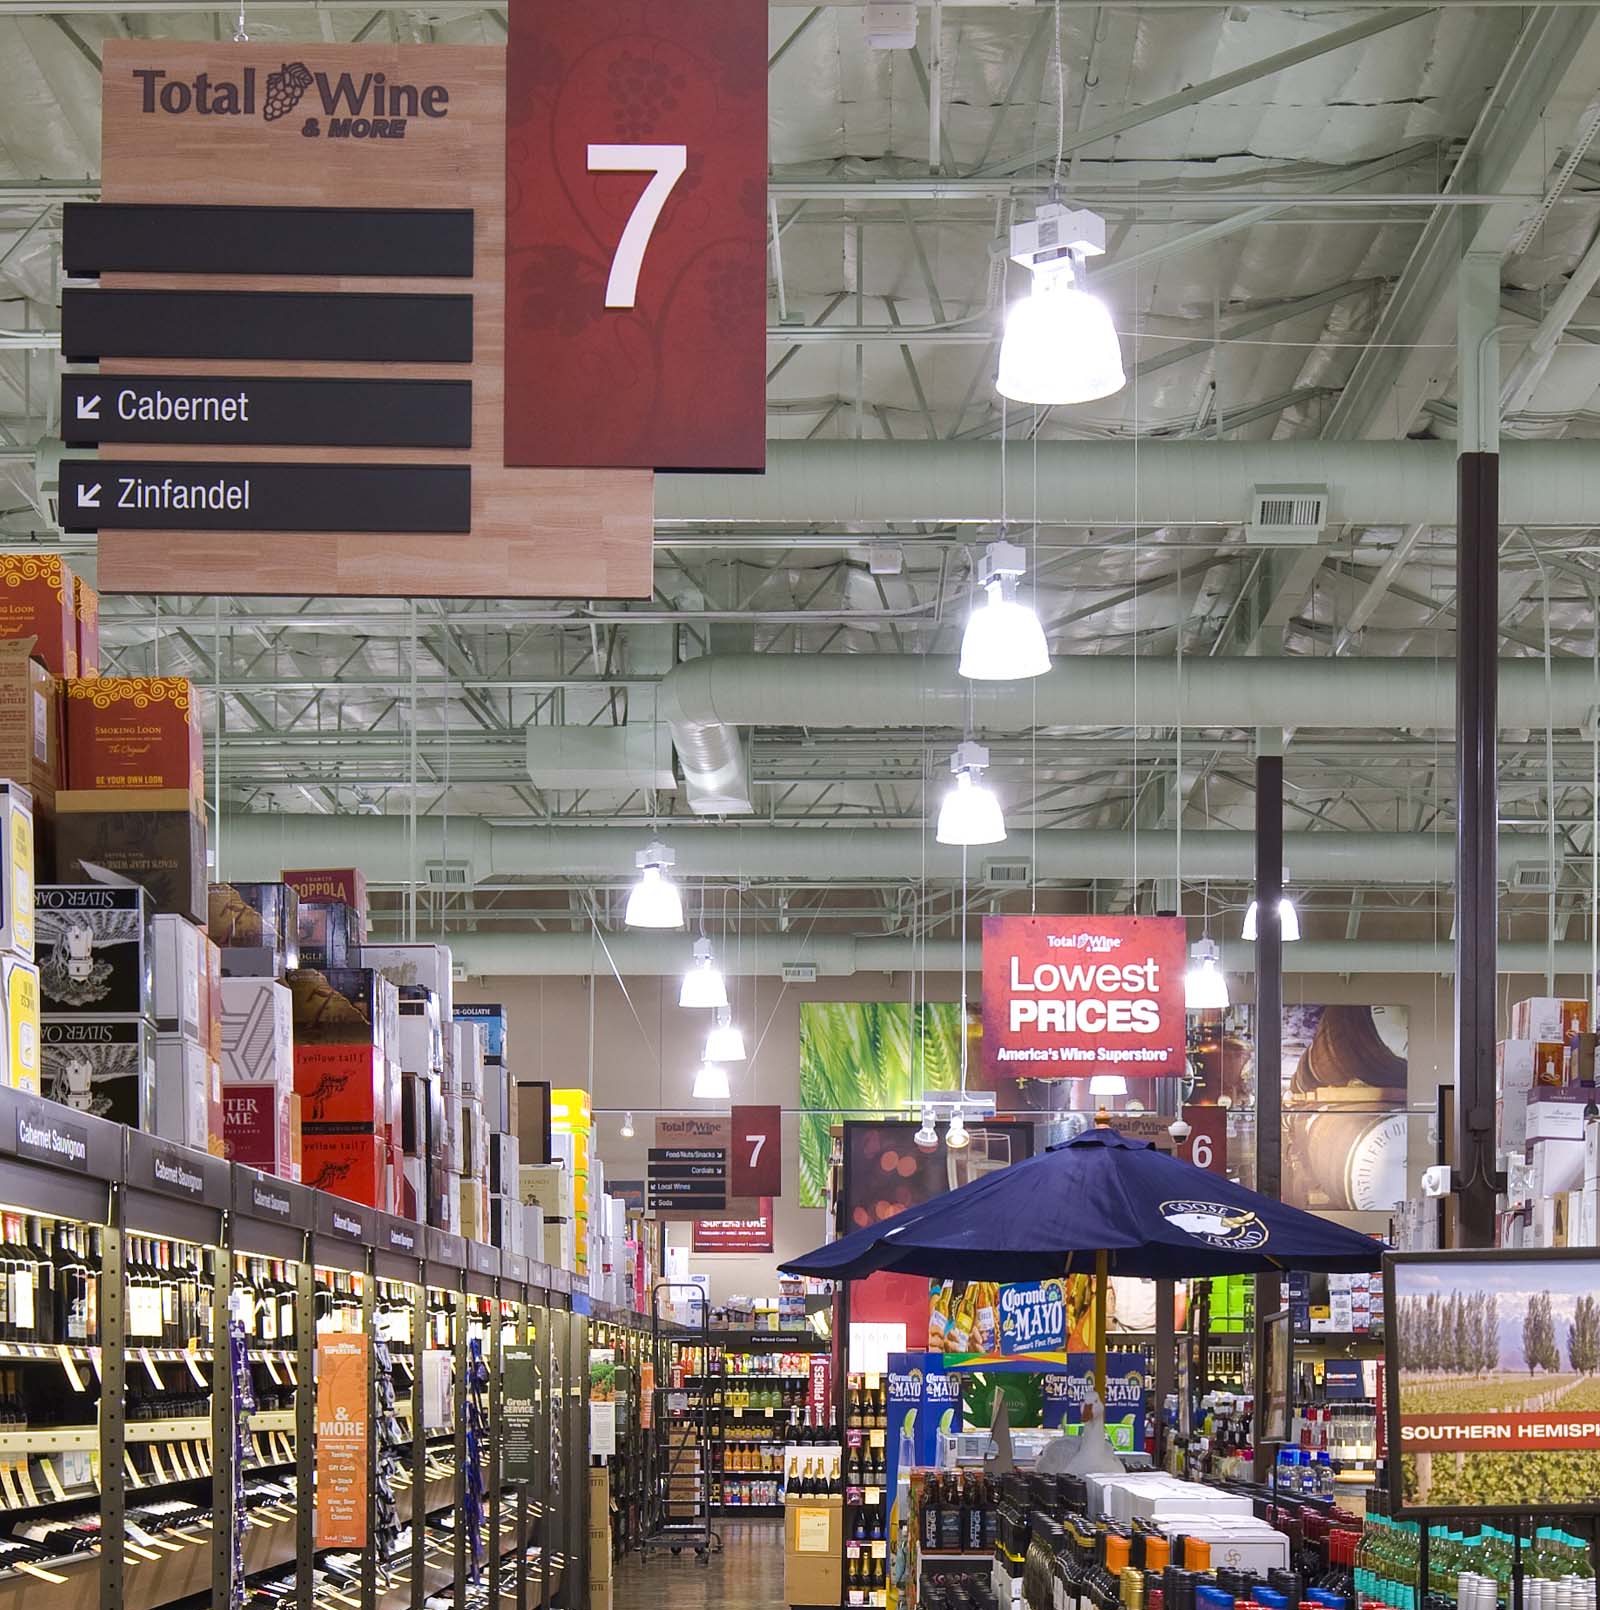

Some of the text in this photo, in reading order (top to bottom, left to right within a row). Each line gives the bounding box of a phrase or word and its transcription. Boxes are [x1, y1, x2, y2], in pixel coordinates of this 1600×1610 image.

[133, 67, 450, 118] Total Wine
[302, 119, 406, 139] & MORE
[587, 144, 687, 308] 7
[117, 390, 249, 422] Cabernet
[117, 479, 250, 510] Zinfandel
[137, 726, 161, 734] LOON
[66, 891, 115, 907] SILVER
[1047, 935, 1121, 947] Total Wine
[1010, 956, 1159, 992] Lowest
[1010, 999, 1160, 1033] PRICES
[997, 1048, 1059, 1061] America's
[1059, 1048, 1095, 1060] Wine
[661, 1122, 684, 1132] Total
[746, 1135, 766, 1167] 7
[1191, 1134, 1212, 1168] 6
[1168, 1202, 1229, 1216] GOOSE
[1206, 1230, 1264, 1249] ISLAND
[1001, 1286, 1046, 1315] Corona
[1013, 1301, 1064, 1343] MAYO
[336, 1407, 348, 1421] &
[320, 1422, 364, 1436] MORE
[1400, 1425, 1511, 1440] SOUTHERN
